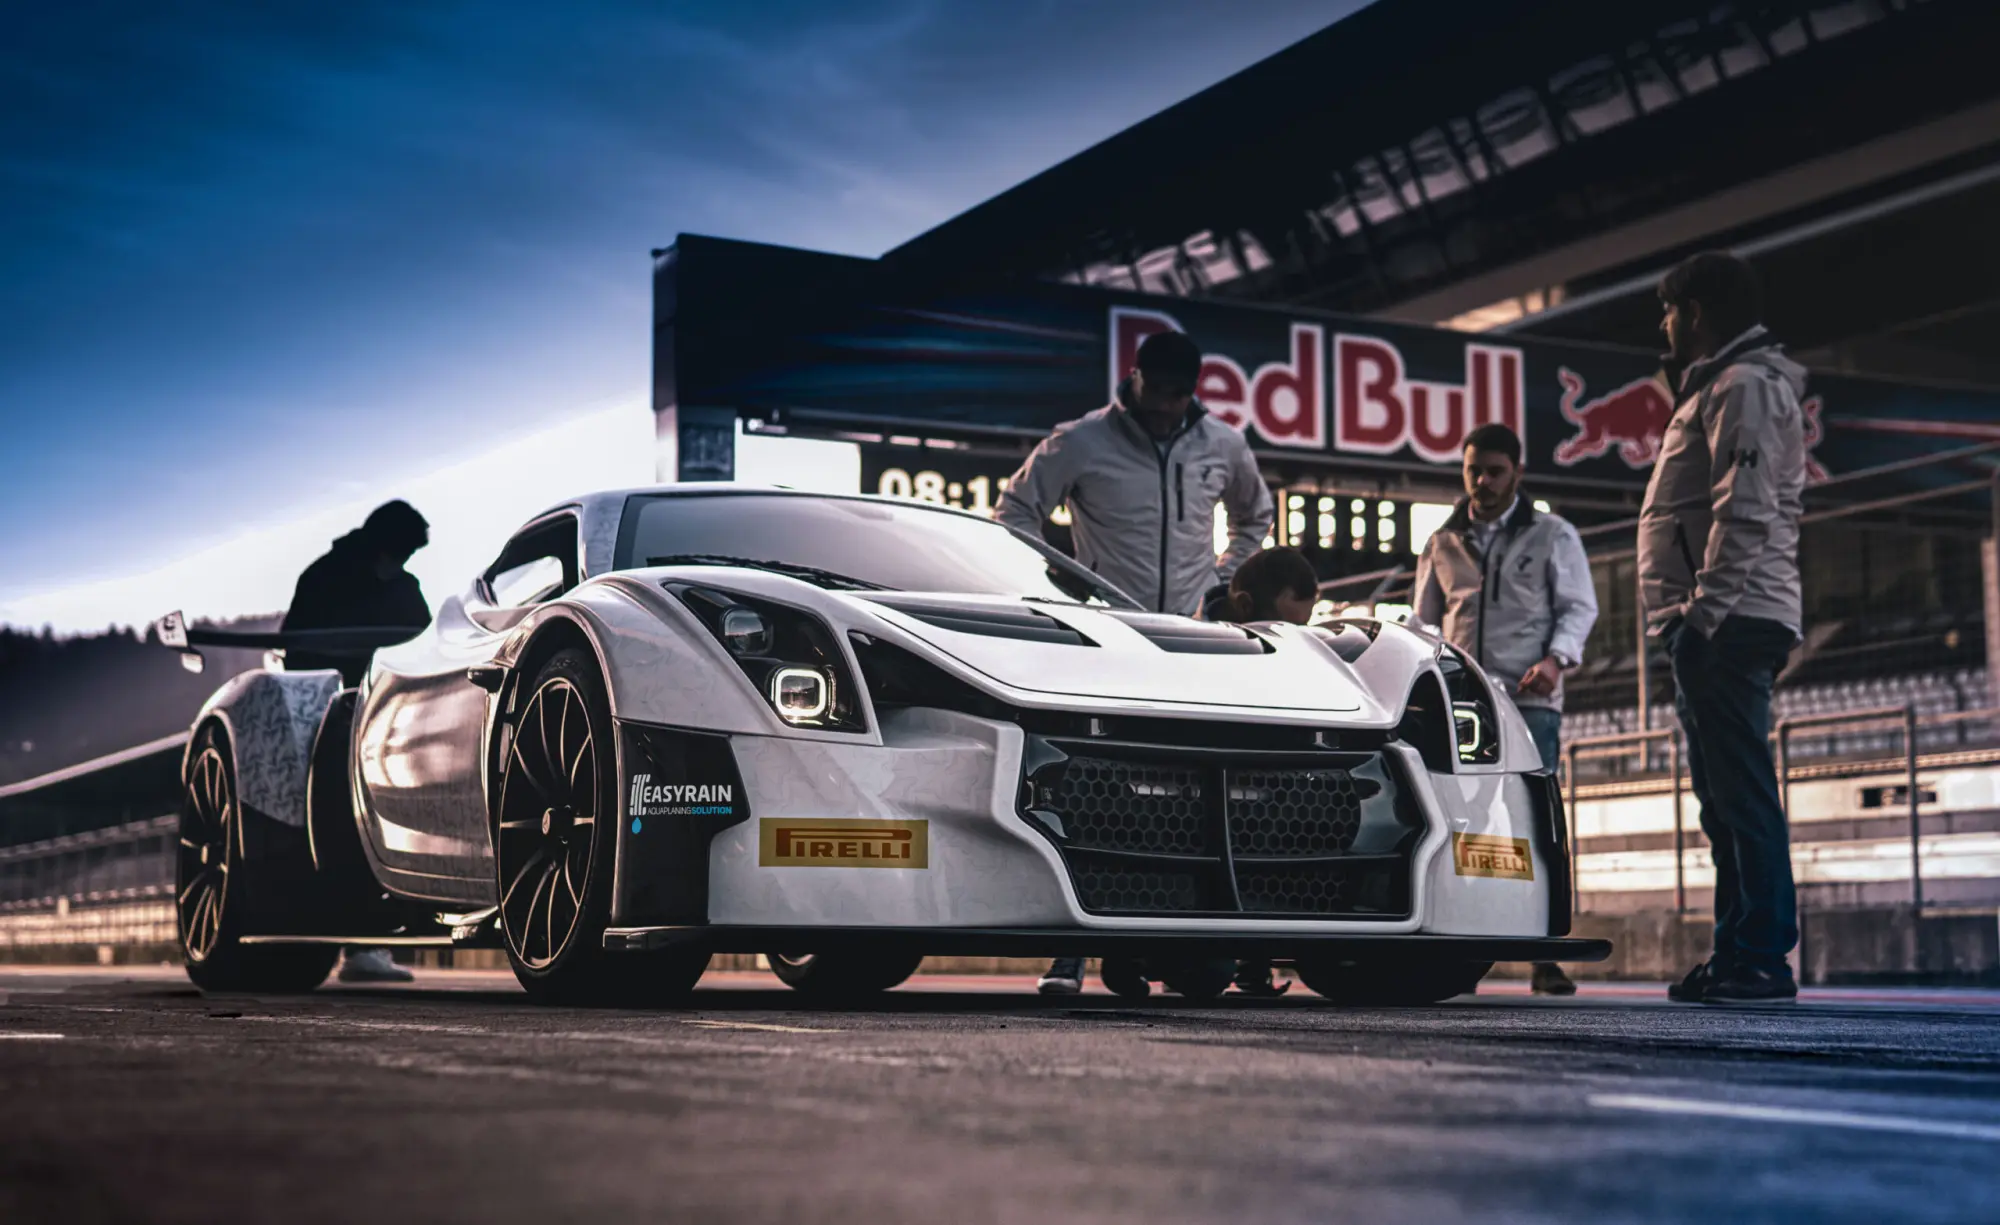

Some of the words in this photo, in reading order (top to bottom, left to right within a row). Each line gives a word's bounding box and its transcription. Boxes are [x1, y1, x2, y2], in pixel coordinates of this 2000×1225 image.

[1334, 333, 1526, 466] Bull
[643, 784, 732, 803] EASYRAIN
[776, 827, 912, 859] PIRELLI
[1459, 841, 1527, 873] PIRELLI
